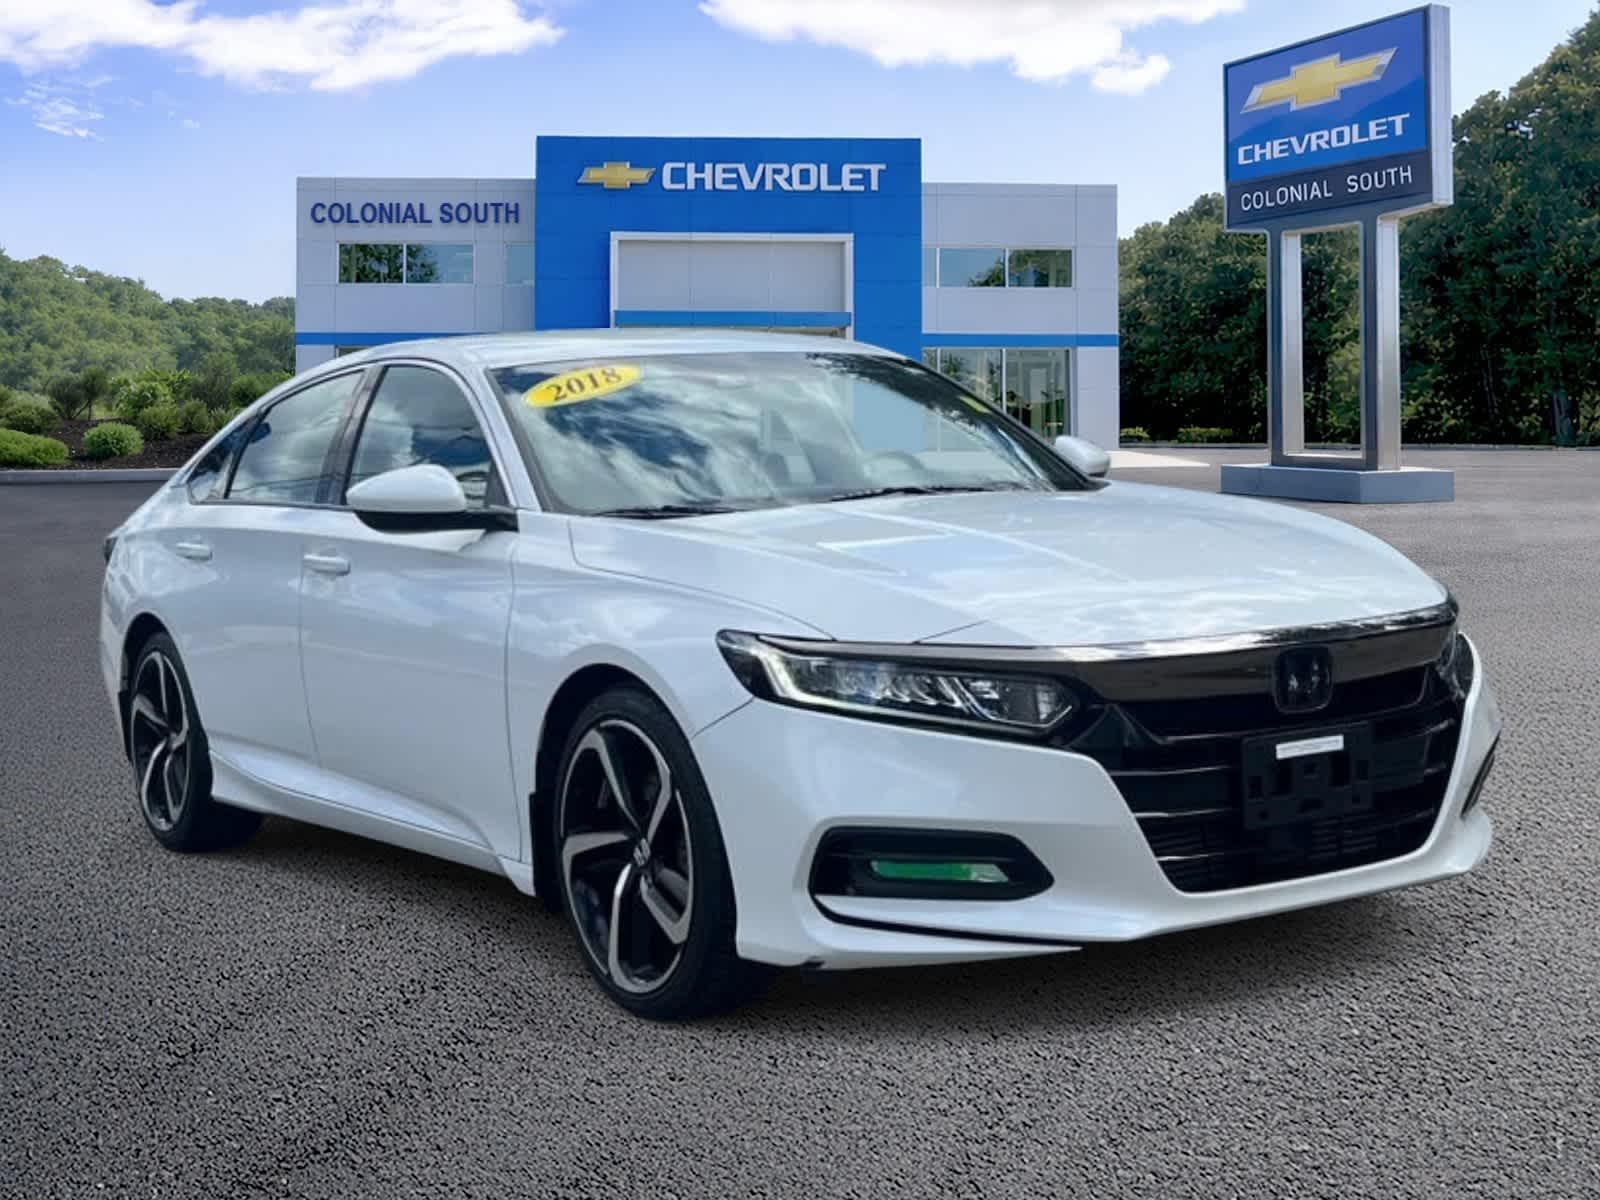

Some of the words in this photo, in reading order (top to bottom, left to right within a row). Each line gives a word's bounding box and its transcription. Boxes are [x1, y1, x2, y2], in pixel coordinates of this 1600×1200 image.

[1237, 113, 1410, 165] CHEVROLET
[661, 162, 887, 192] CHEVROLET
[1240, 180, 1333, 211] COLONIAL
[1346, 165, 1413, 193] SOUTH
[310, 202, 434, 224] COLONIAL
[439, 202, 521, 224] SOUTH
[546, 366, 623, 401] 2018
